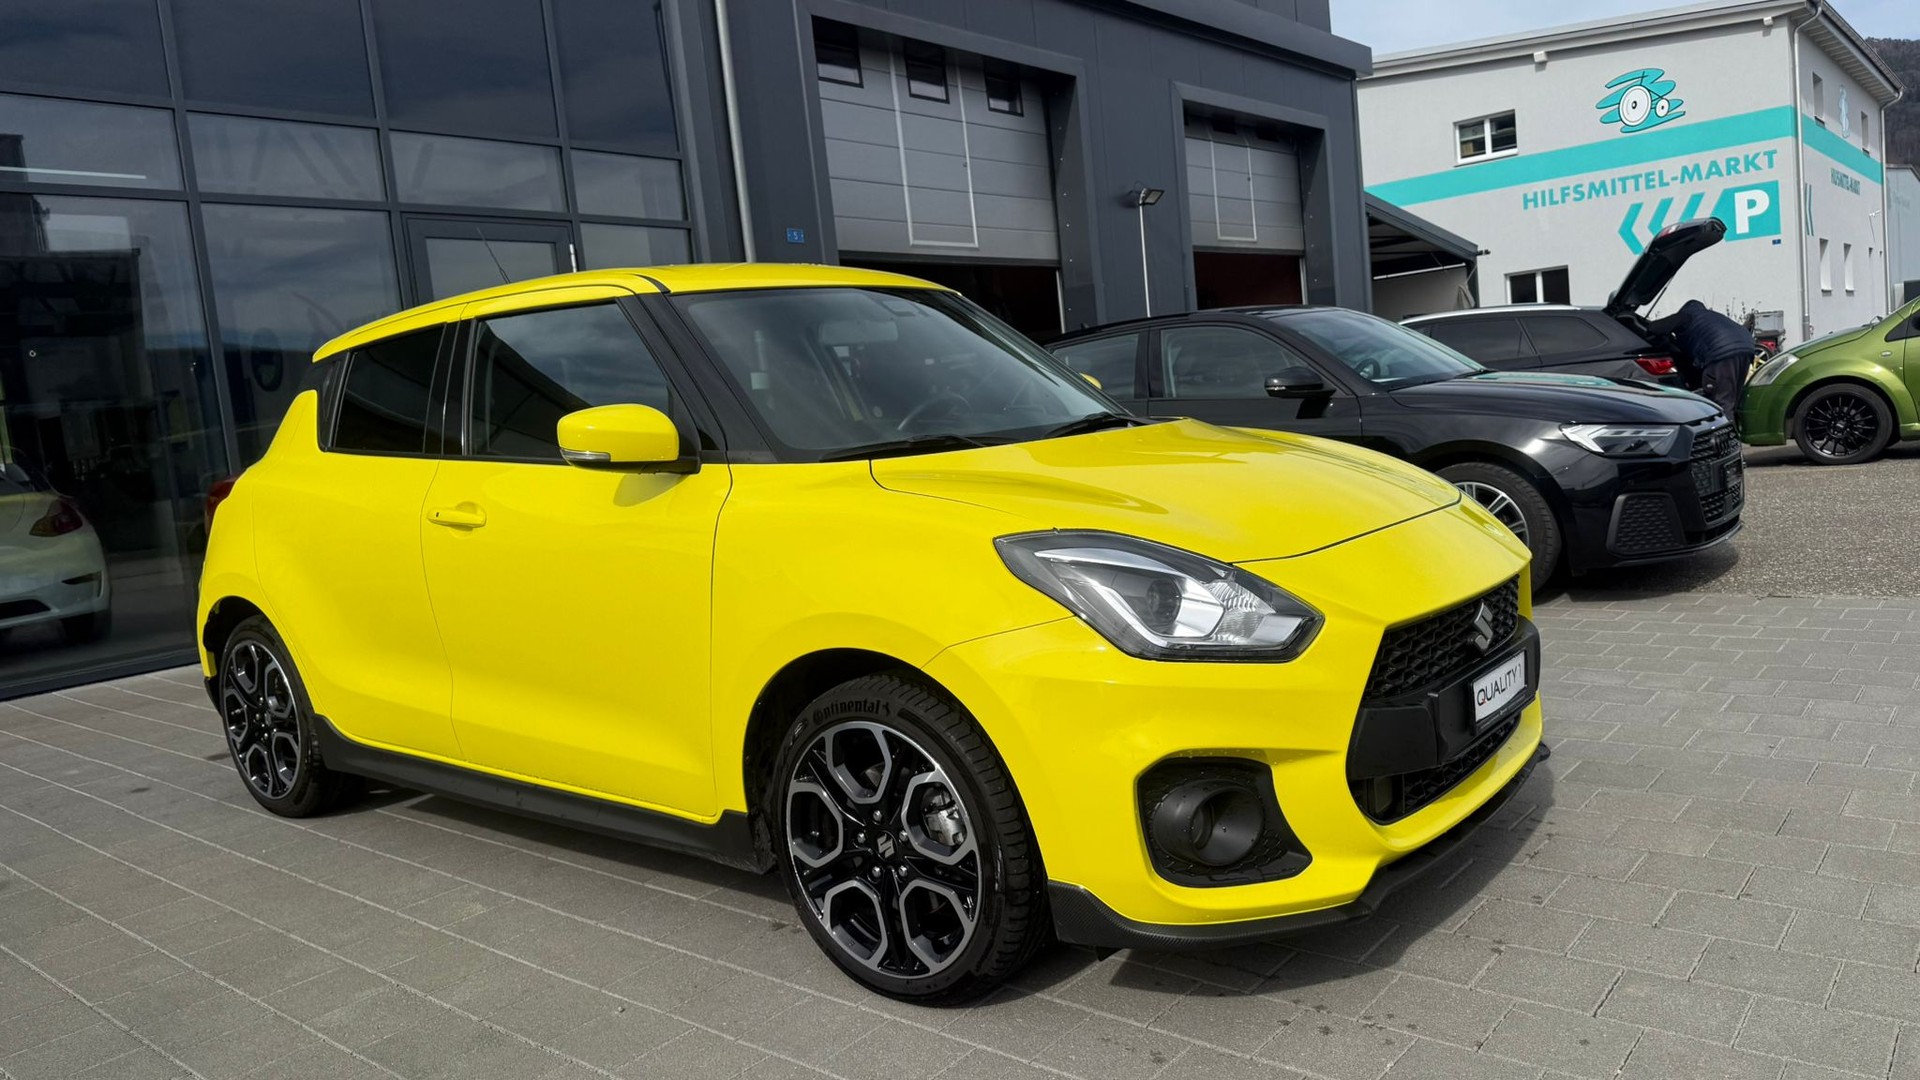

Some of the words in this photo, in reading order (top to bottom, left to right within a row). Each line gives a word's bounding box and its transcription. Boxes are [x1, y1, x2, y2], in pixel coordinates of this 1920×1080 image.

[1522, 150, 1778, 210] HILFSMITTEL-MARKT
[1734, 189, 1770, 235] P
[1477, 666, 1517, 706] QUALITY
[813, 699, 880, 724] Continental
